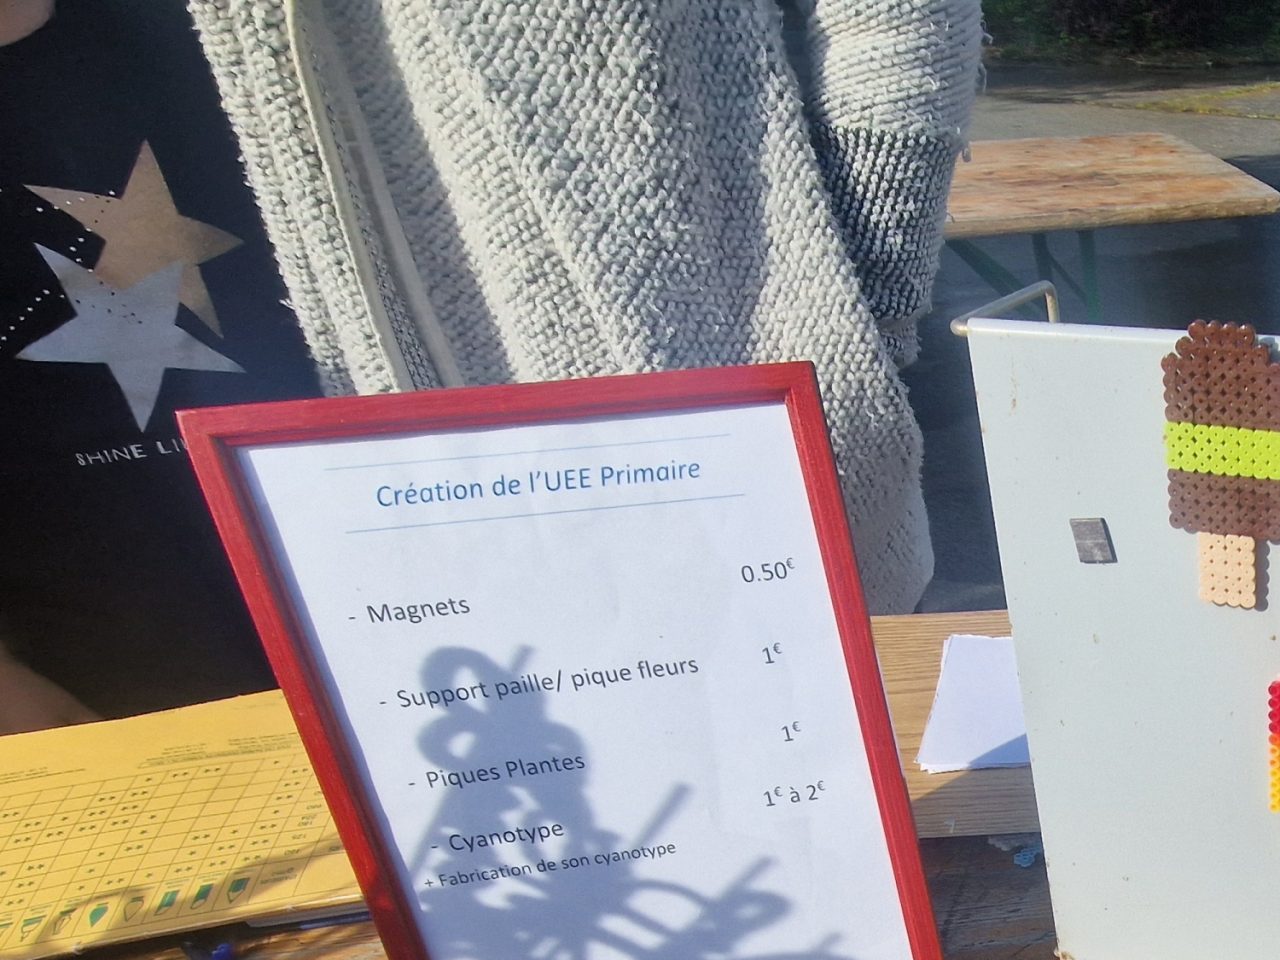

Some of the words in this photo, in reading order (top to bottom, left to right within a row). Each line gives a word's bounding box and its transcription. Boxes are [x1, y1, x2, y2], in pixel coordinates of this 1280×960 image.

[75, 443, 147, 466] SHINE
[376, 482, 484, 508] Création
[491, 474, 521, 497] de
[600, 460, 701, 487] Primaire
[366, 597, 471, 624] Magnets
[396, 682, 489, 709] Support
[570, 667, 632, 692] pique
[637, 657, 700, 680] fleurs
[425, 765, 501, 790] Piques
[505, 754, 586, 778] Plantes
[789, 786, 801, 803] à
[448, 822, 565, 852] Cyanotype
[438, 863, 532, 887] Fabrication
[536, 858, 557, 874] de
[561, 856, 590, 870] son
[593, 842, 677, 867] cyanotype
